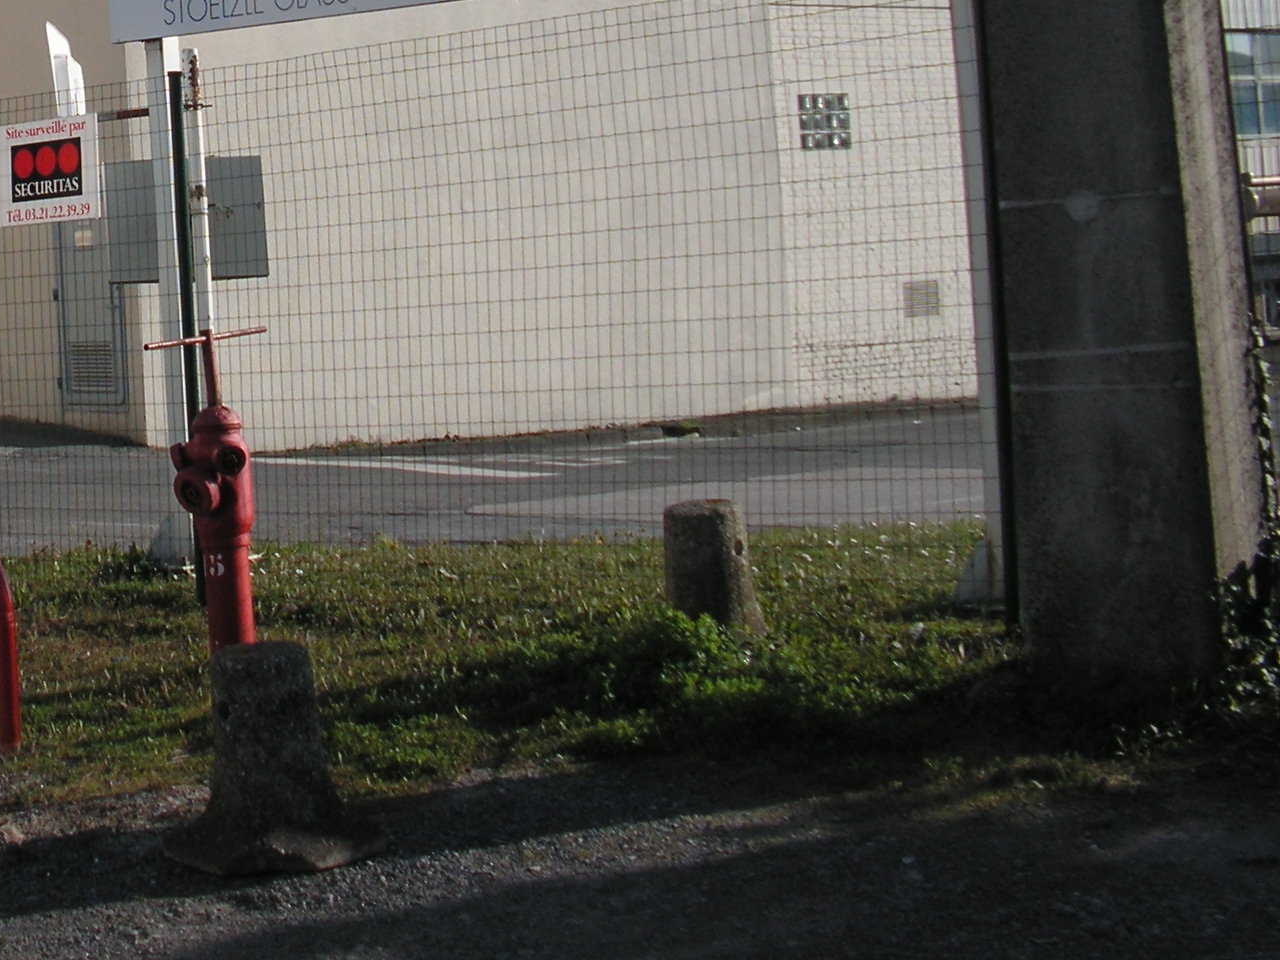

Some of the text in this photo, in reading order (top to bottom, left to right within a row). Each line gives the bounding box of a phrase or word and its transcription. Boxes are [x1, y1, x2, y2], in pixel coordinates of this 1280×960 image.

[5, 119, 87, 140] Site surveillé par
[14, 177, 79, 198] SECURITAS
